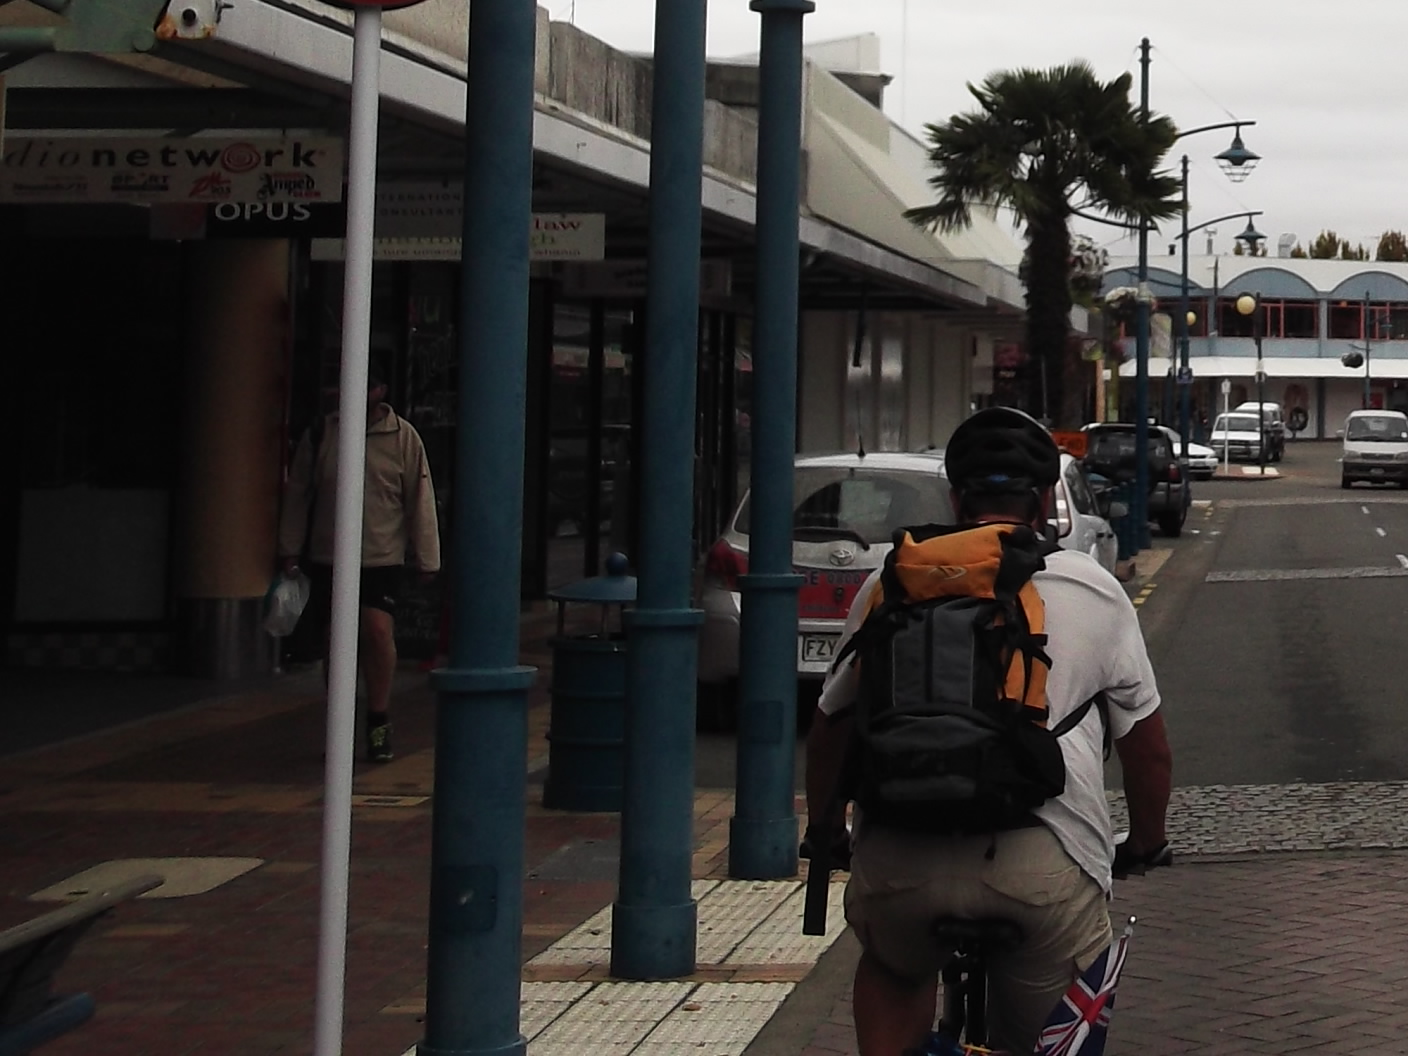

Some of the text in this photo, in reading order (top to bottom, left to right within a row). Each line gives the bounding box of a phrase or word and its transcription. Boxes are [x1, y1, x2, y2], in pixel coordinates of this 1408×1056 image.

[380, 193, 462, 201] TERNATION
[215, 201, 312, 222] OPUS
[380, 207, 463, 217] ONSULTANT
[535, 218, 582, 231] law
[806, 640, 837, 656] FZY
